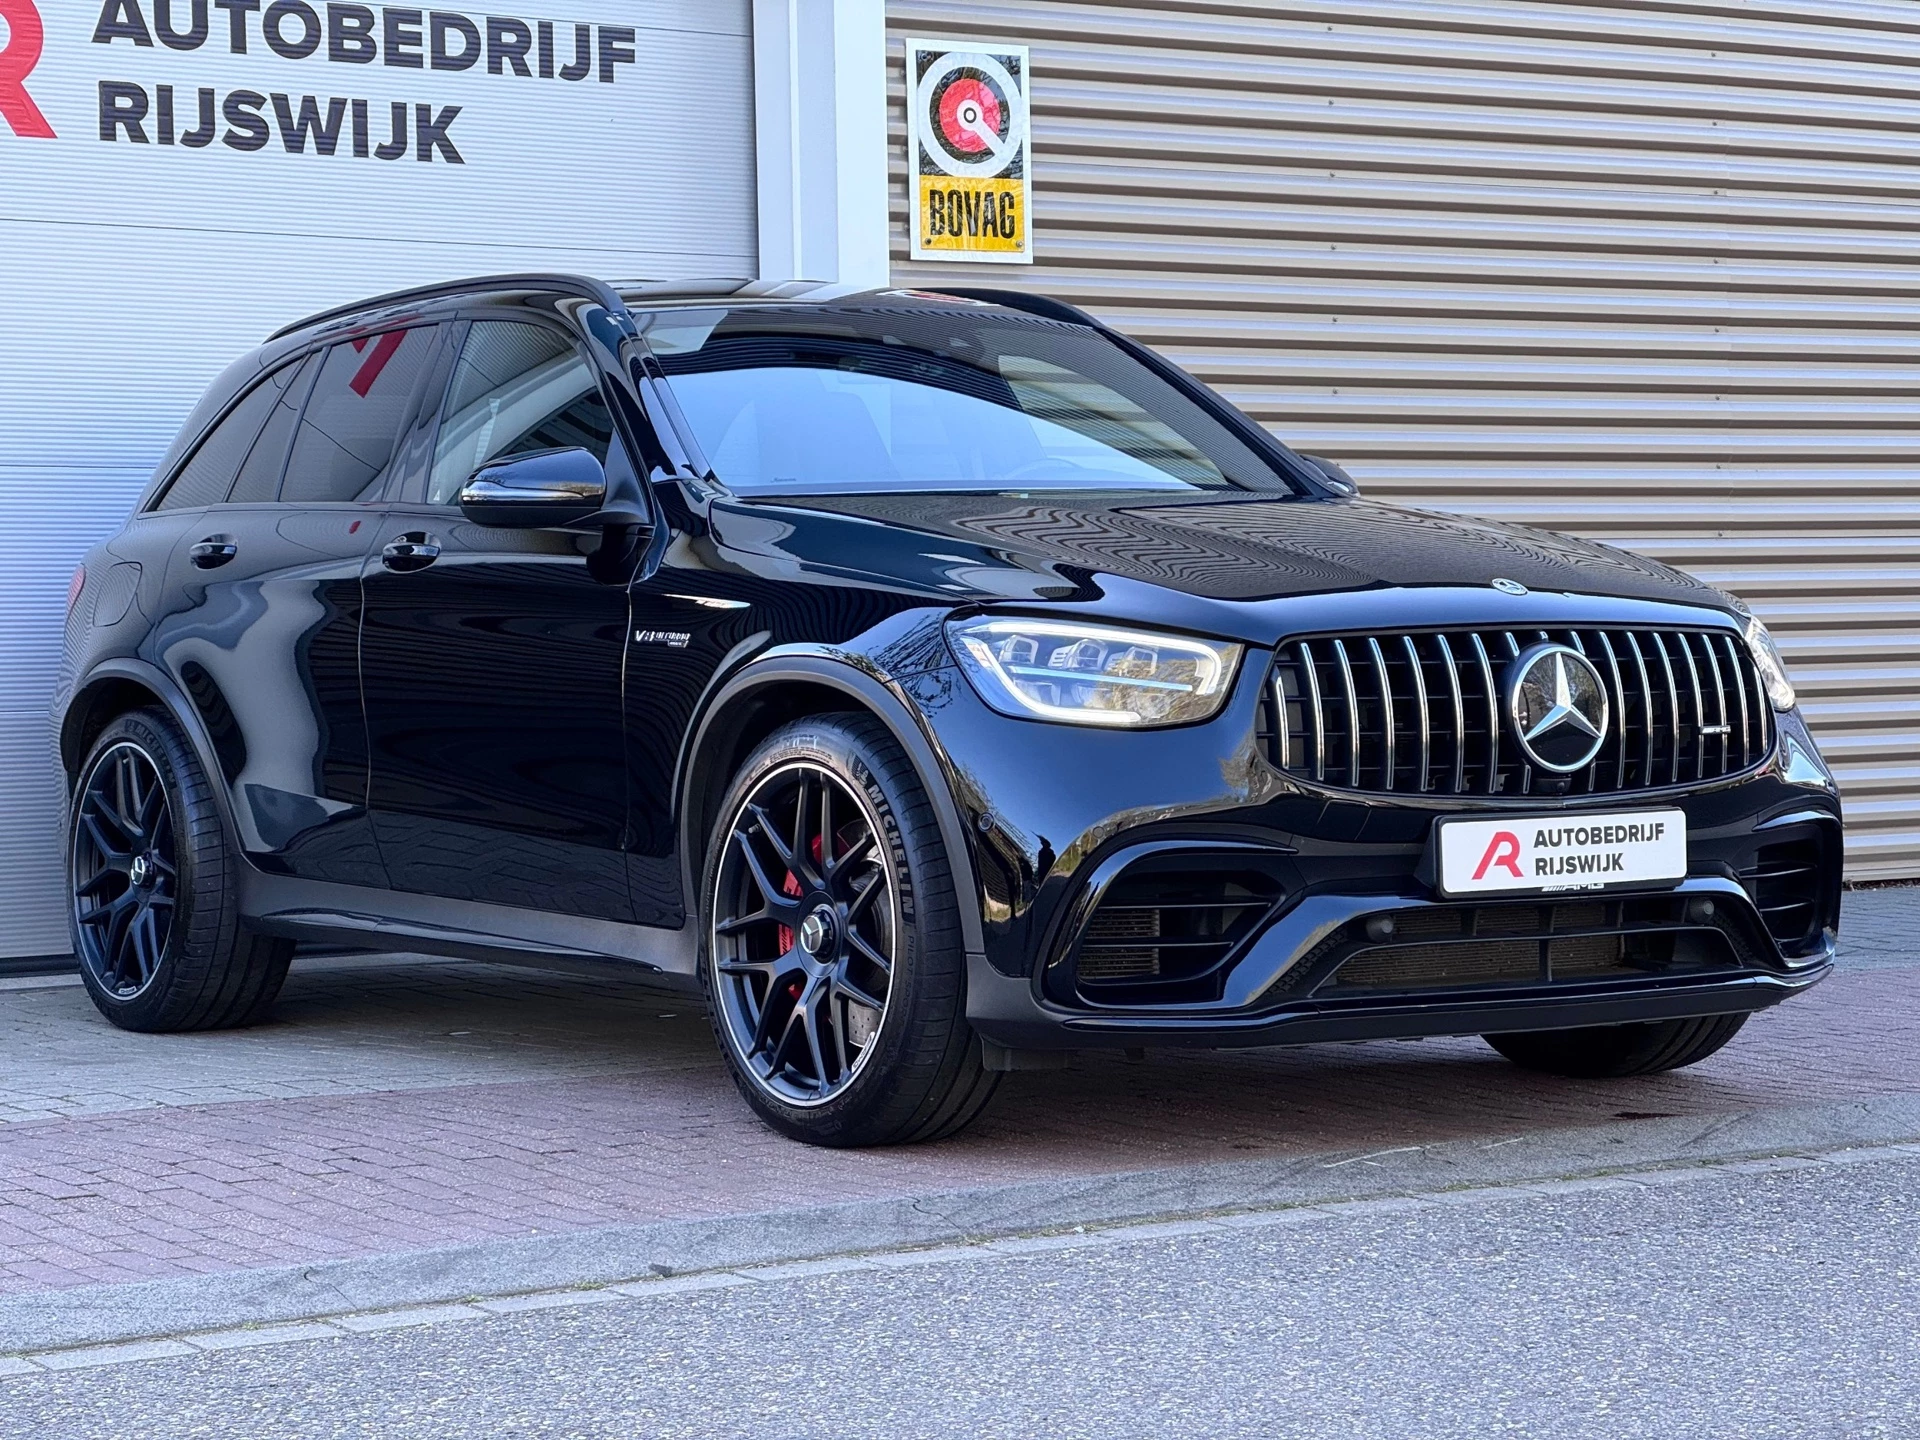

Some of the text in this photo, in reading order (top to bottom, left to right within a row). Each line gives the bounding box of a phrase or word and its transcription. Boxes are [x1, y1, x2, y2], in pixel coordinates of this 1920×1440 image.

[92, 0, 636, 84] AUTOBEDRIJF
[98, 80, 466, 165] RIJSWIJK
[929, 189, 1015, 239] BOVAG
[868, 784, 915, 915] MICHELIN
[1533, 823, 1665, 849] AUTOBEDRIJF
[1534, 853, 1624, 876] RIJSWIJK
